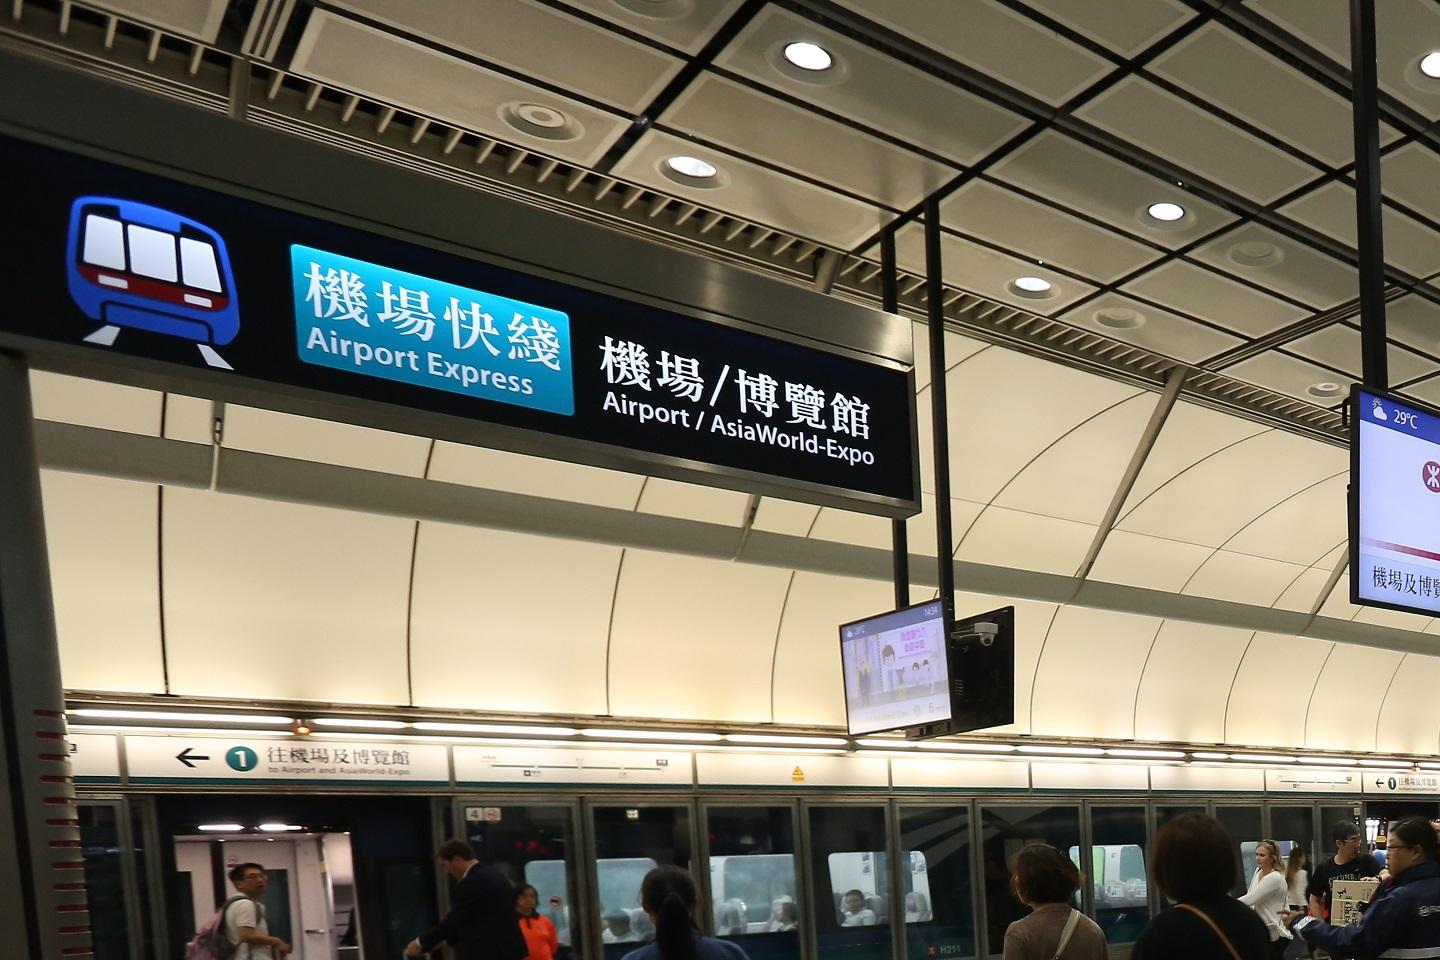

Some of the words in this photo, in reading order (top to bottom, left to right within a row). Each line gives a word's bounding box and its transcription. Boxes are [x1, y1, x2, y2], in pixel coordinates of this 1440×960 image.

[304, 261, 561, 371] 機場快綫
[306, 326, 420, 372] Airport
[427, 351, 534, 395] Express
[602, 391, 690, 428] Airport
[710, 414, 875, 466] AsiaWorld-Expo
[1393, 409, 1418, 430] 29°C
[280, 766, 316, 776] Airport
[319, 767, 337, 775] and
